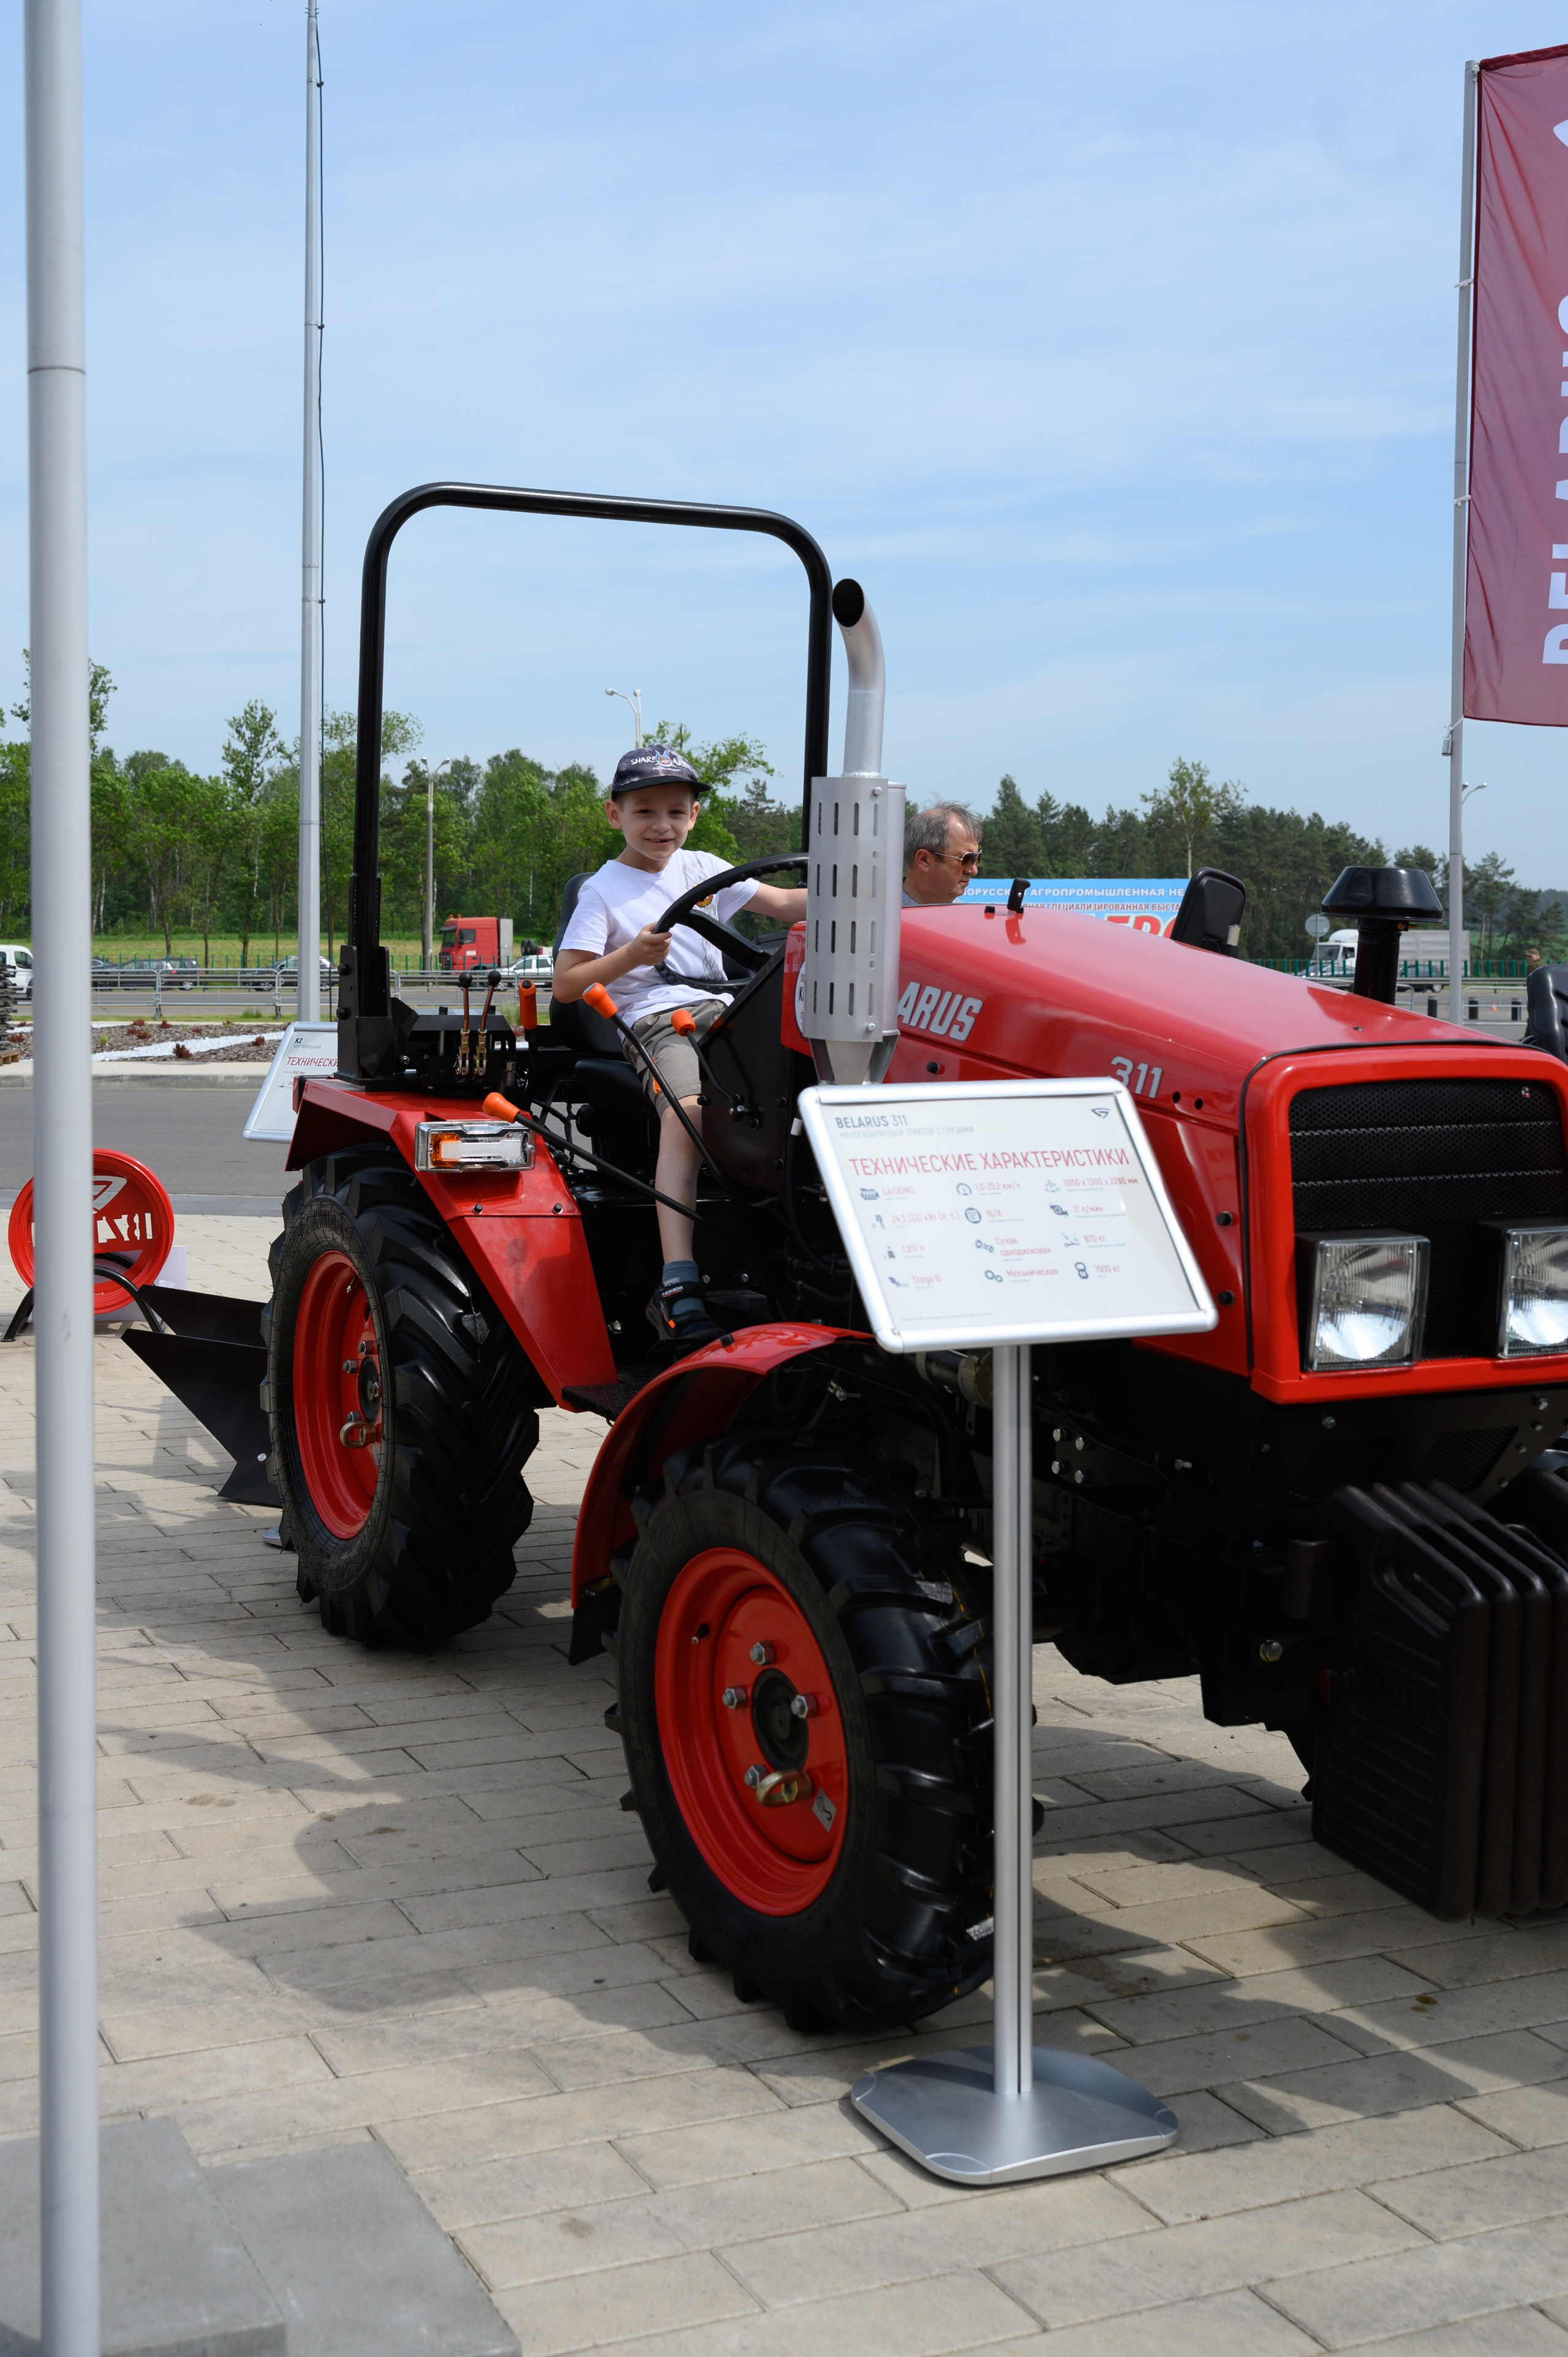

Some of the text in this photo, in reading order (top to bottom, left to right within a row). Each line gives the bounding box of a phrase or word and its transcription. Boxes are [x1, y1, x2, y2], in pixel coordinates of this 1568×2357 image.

[1030, 888, 1165, 897] АГРОПРОМЫШЛЕННАЯ
[1169, 888, 1185, 897] НЕ
[1047, 903, 1149, 911] СПЕЦИАЛИЗИРОВАННАЯ
[1152, 903, 1180, 911] ВЫСТА
[898, 981, 984, 1041] ARUS
[287, 1057, 338, 1066] ТЕХНИЧЕСКИ
[1107, 1056, 1163, 1098] 311
[835, 1115, 908, 1128] BELARUS 311
[905, 1127, 935, 1136] ТРАКТОР
[849, 1148, 1130, 1175] ТЕХНИЧЕСКИЕ ХАРАКТЕРИСТИКИ
[1063, 1178, 1080, 1187] 3050
[1087, 1178, 1103, 1186] 1300
[1000, 1247, 1052, 1256] однодисковая
[911, 1275, 933, 1284] Stage
